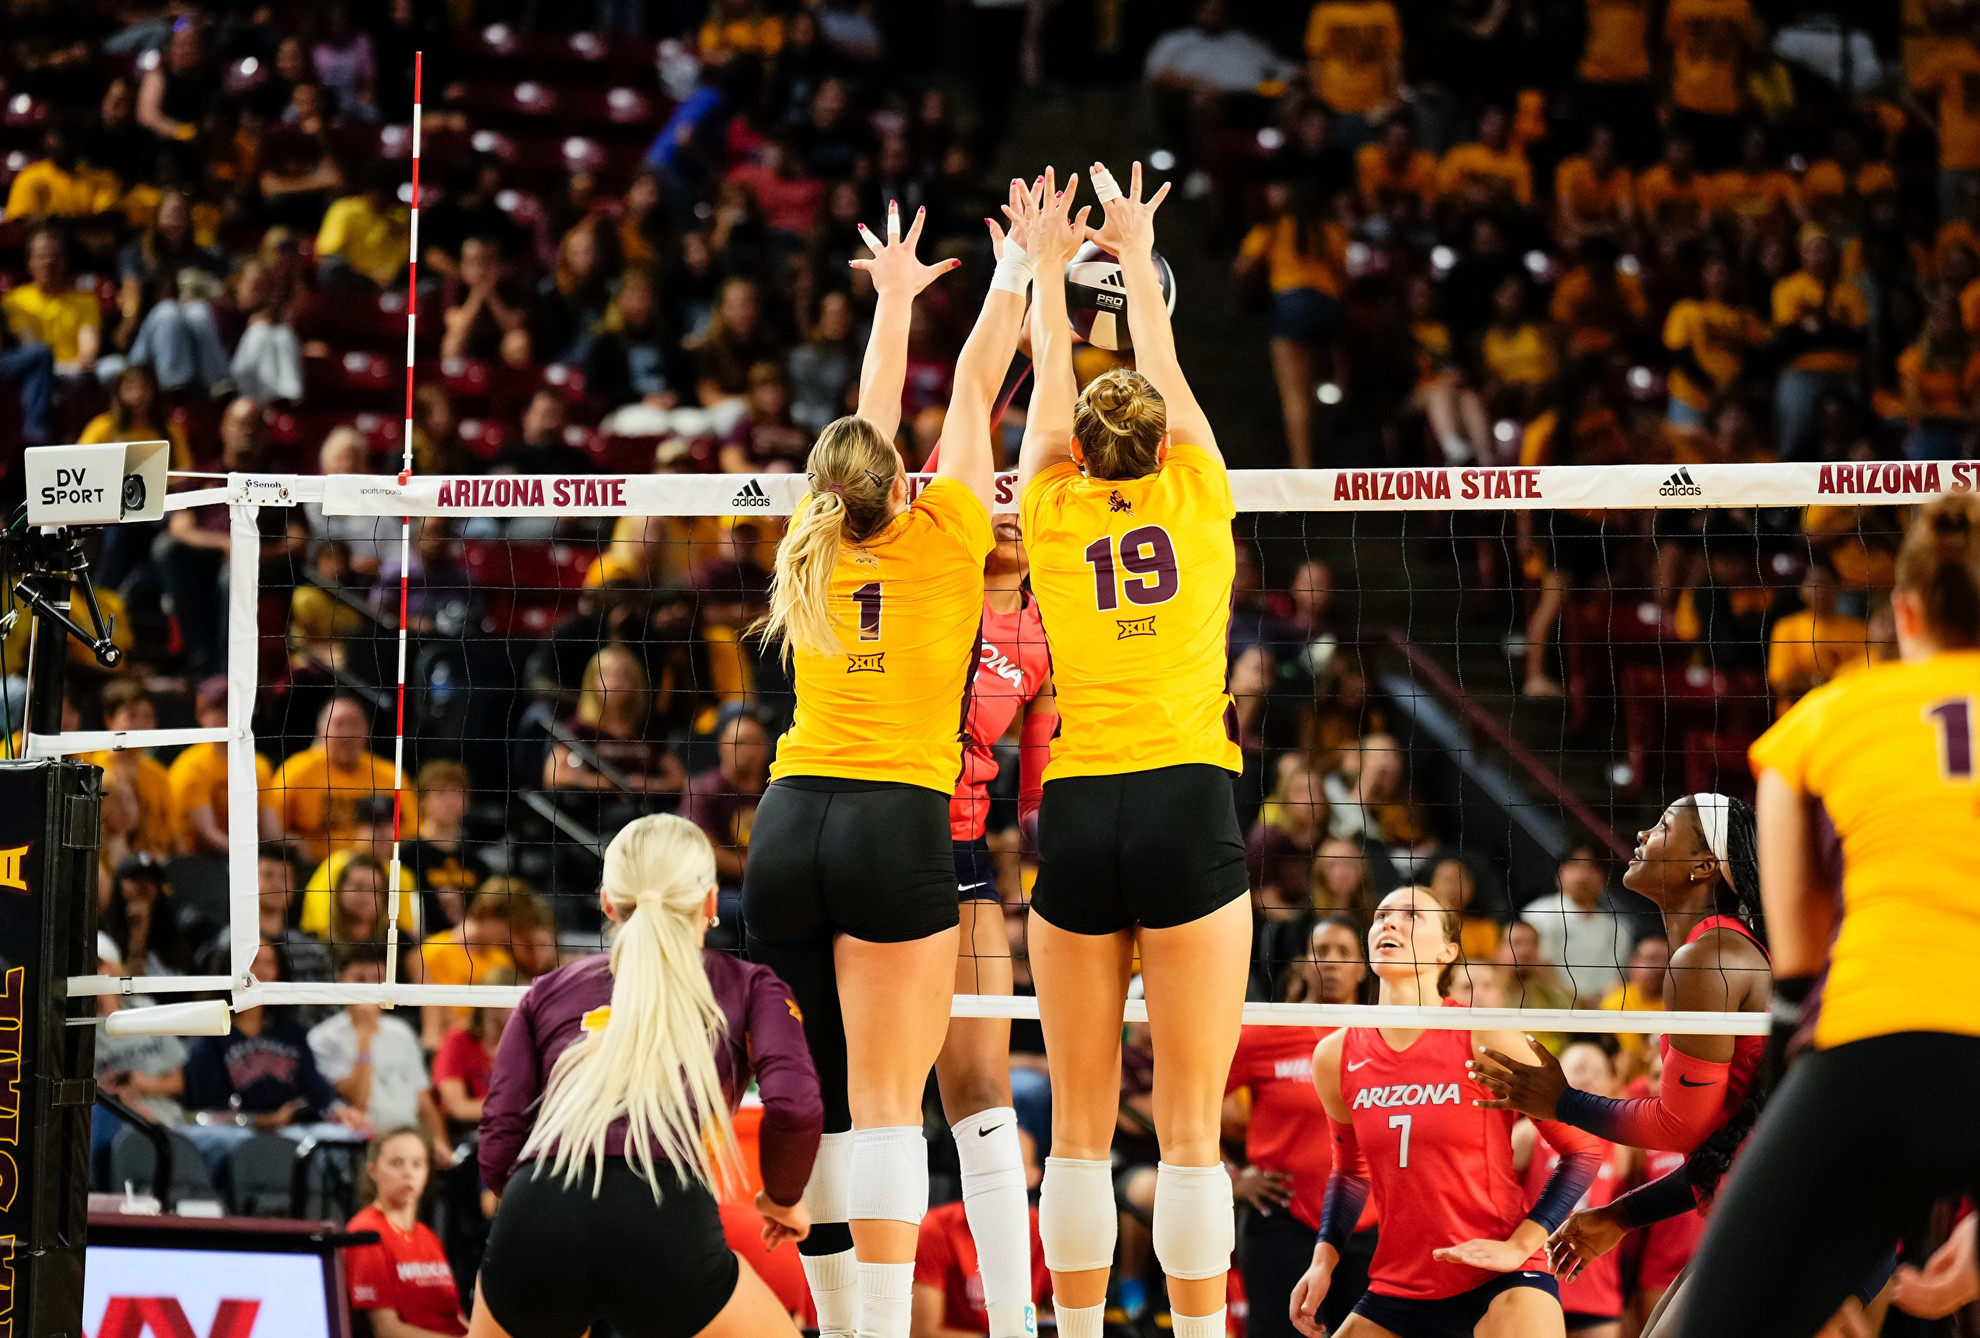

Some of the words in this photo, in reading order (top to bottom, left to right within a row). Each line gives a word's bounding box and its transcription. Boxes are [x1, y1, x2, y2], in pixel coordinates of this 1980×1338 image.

[1097, 294, 1123, 305] PRO
[57, 468, 86, 487] DV
[253, 480, 281, 489] Senoh
[1334, 470, 1451, 501] ARIZONA
[1461, 469, 1542, 499] STATE
[1659, 485, 1702, 496] adidas
[1818, 463, 1941, 494] ARIZONA
[437, 479, 545, 507] ARIZONA
[553, 478, 627, 507] STATE
[732, 496, 770, 507] adidas
[1084, 525, 1179, 612] 19
[851, 581, 882, 642] 1
[1352, 1083, 1460, 1110] ARIZONA
[1388, 1114, 1412, 1168] 7
